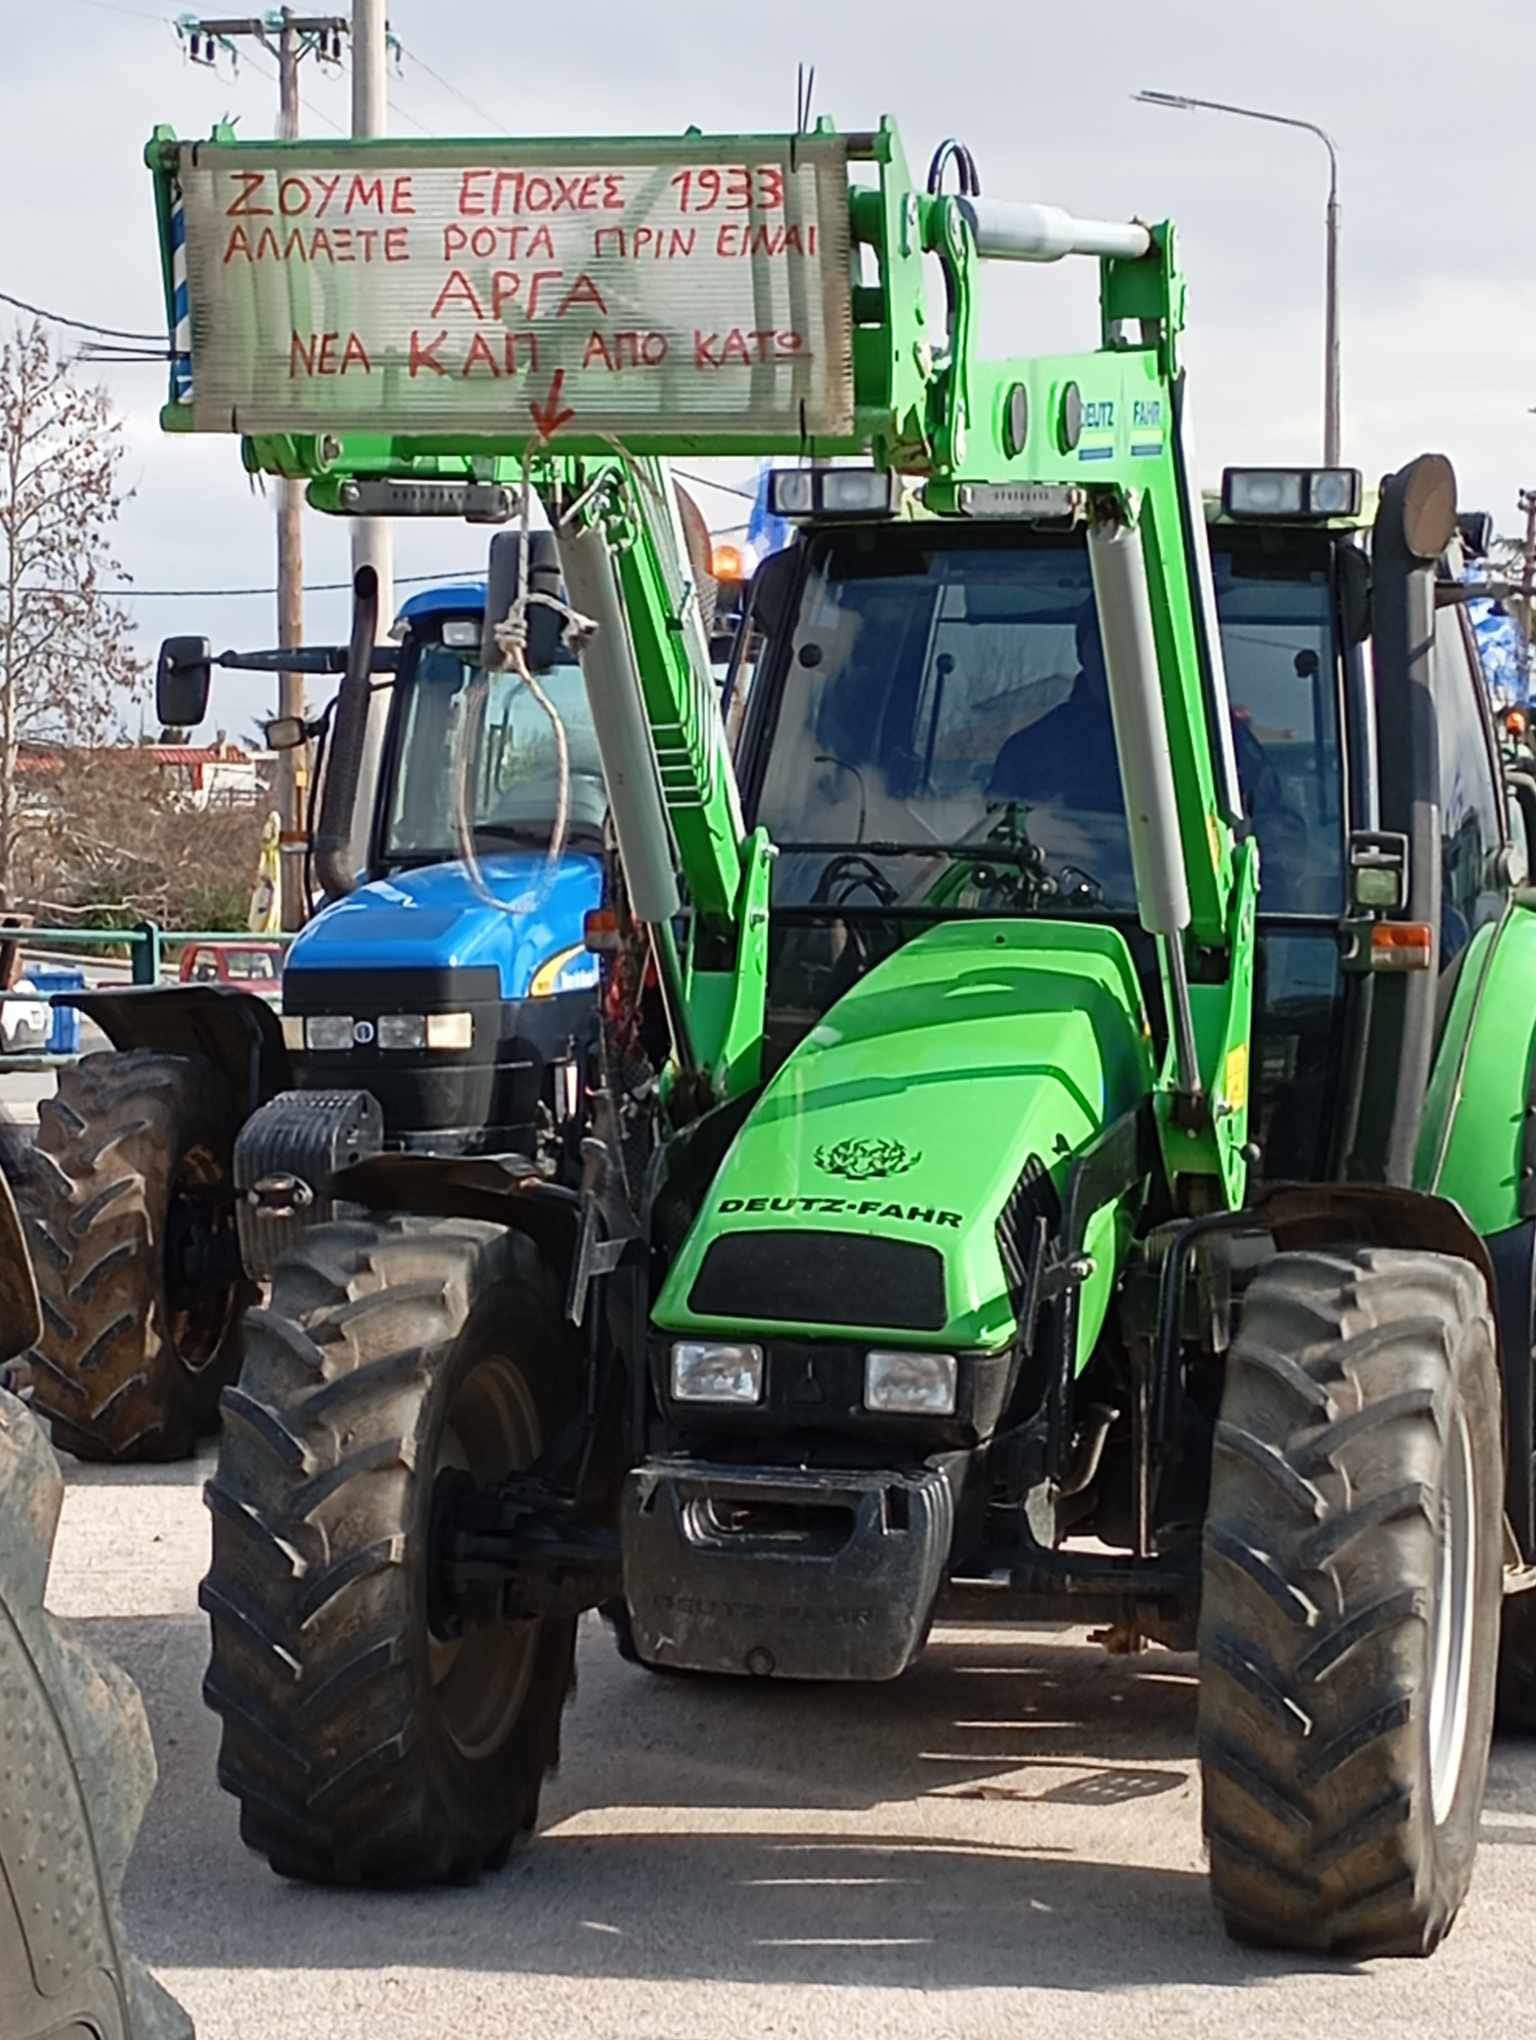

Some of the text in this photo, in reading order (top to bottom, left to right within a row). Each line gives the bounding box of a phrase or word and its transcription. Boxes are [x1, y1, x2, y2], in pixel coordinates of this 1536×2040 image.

[226, 168, 784, 218] ΖΟΥΜΕ ΕΠΟΧΕΣ 1933
[223, 223, 816, 264] ΑΛΛΑΞΤΕ ΡΟΤΑ ΠΡΙΝ ΕΙΝΑΙ
[430, 270, 608, 320] ΑΡΓΑ
[289, 330, 371, 378] ΝΕΑ
[408, 329, 540, 377] ΚΑΠ
[582, 329, 669, 372] ΑΠΟ
[1080, 401, 1114, 428] EUTZ
[717, 1197, 963, 1229] DEUTZ-FAHR
